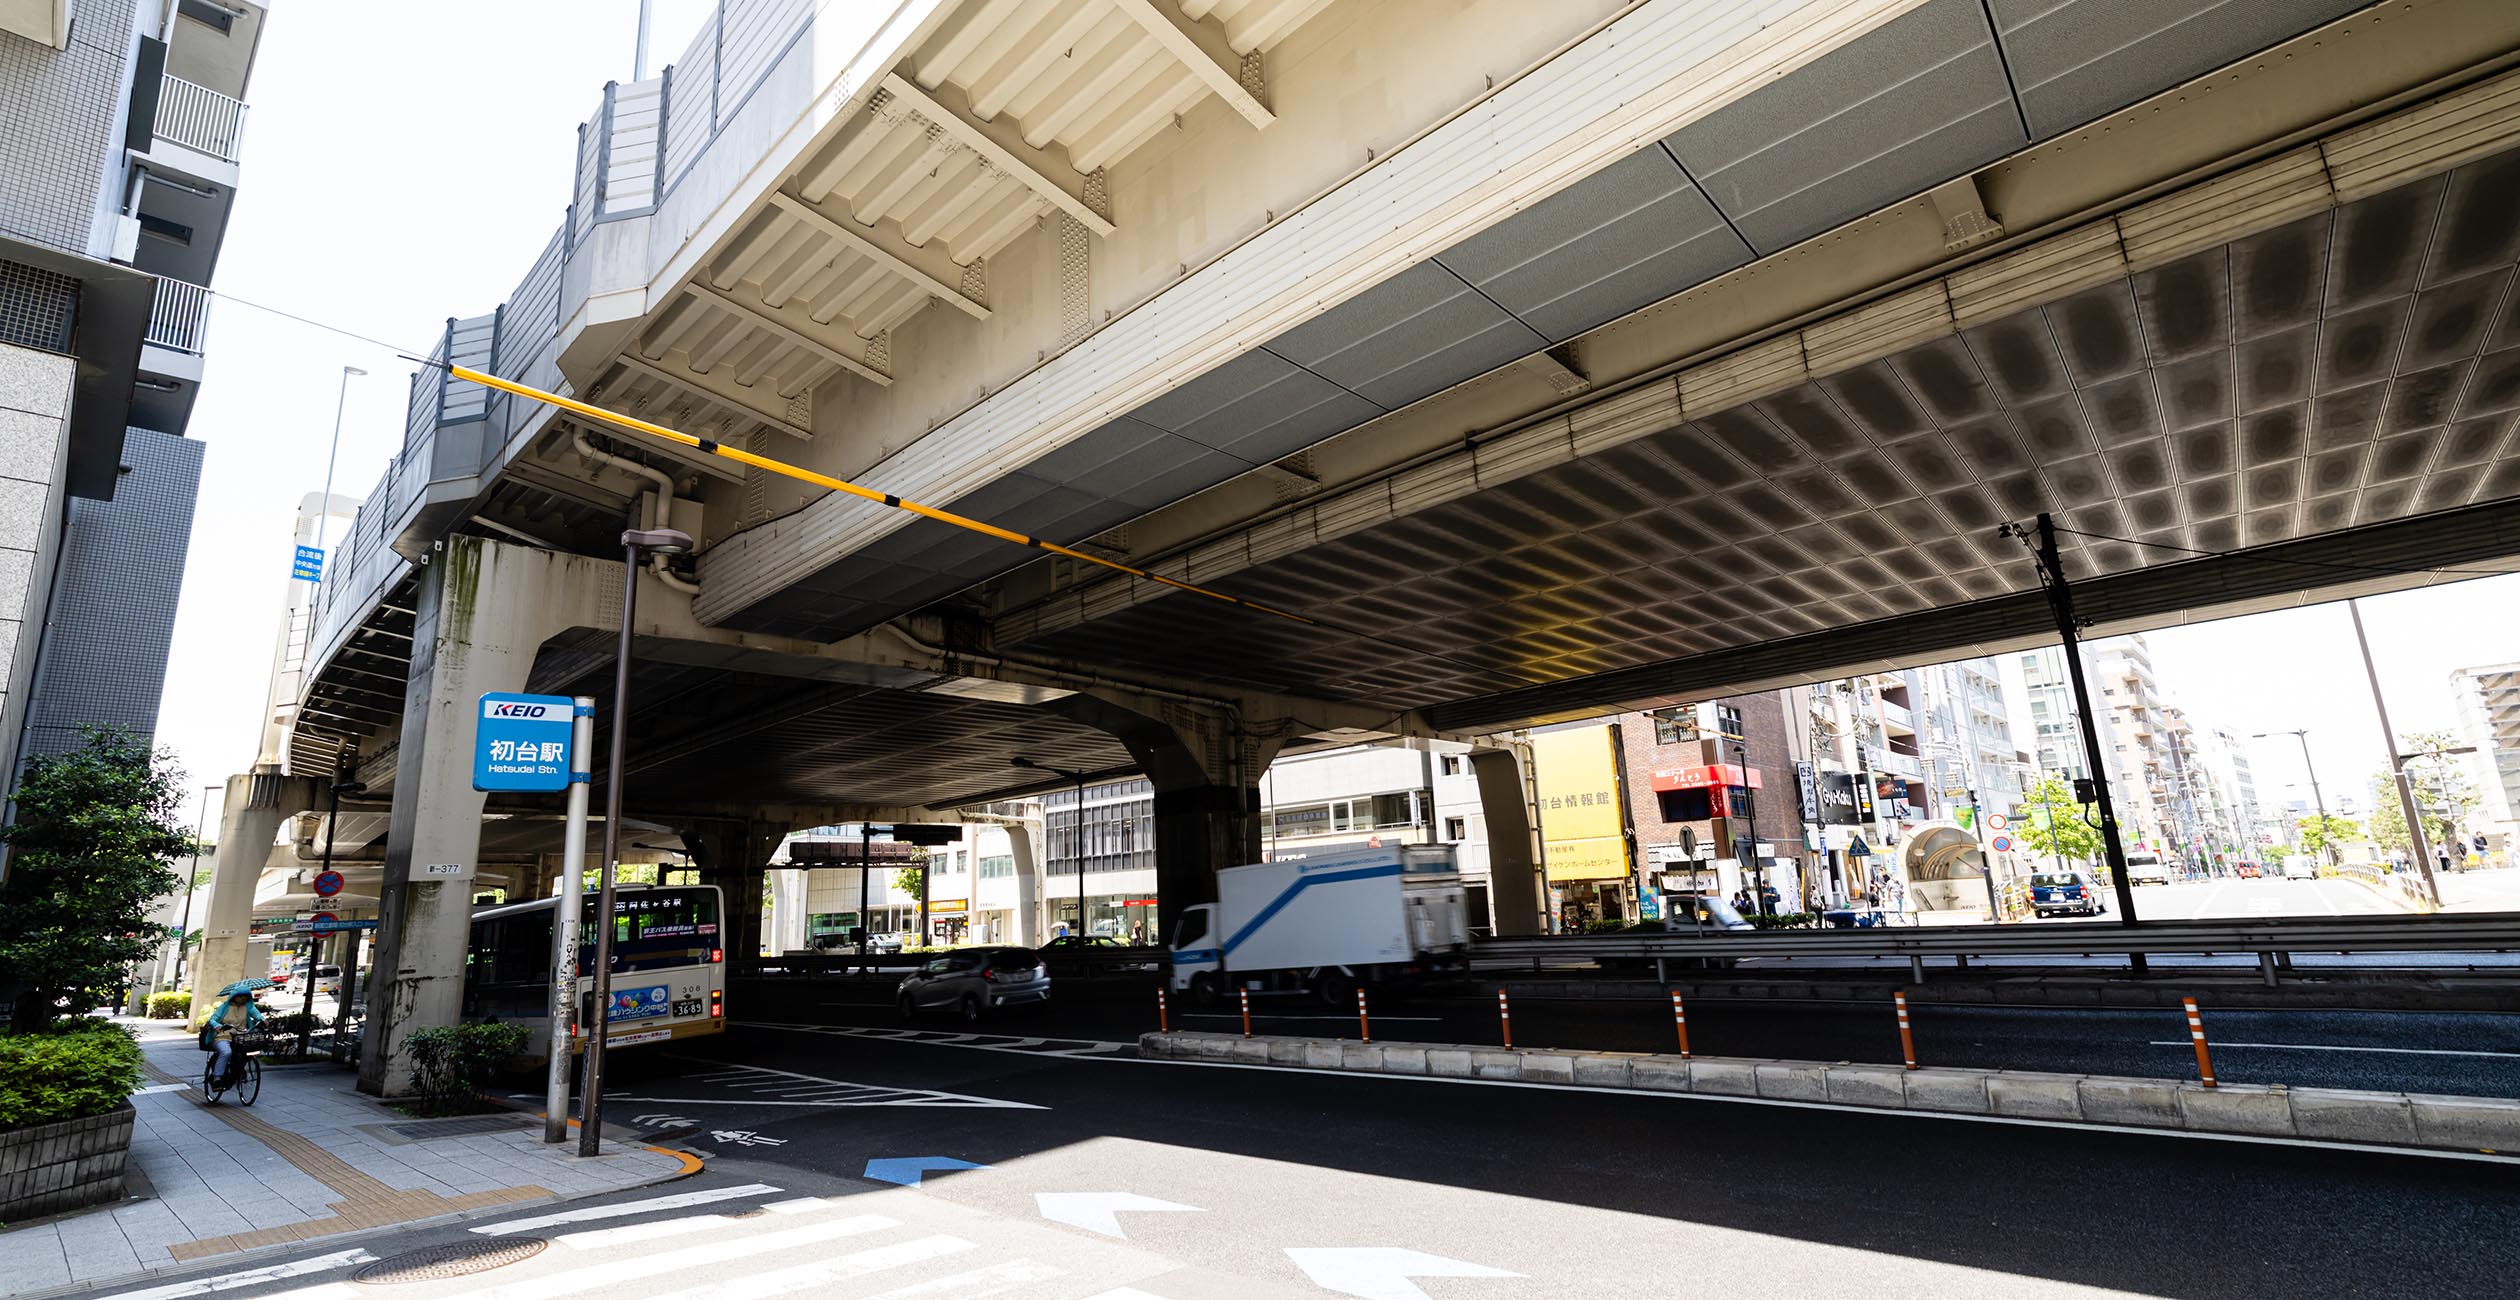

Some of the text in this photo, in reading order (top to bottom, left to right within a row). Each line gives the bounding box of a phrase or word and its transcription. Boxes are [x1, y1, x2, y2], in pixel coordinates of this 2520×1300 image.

[493, 703, 546, 718] KEIO
[489, 739, 564, 762] 初台駅
[488, 764, 558, 774] Hatsudai Stn.
